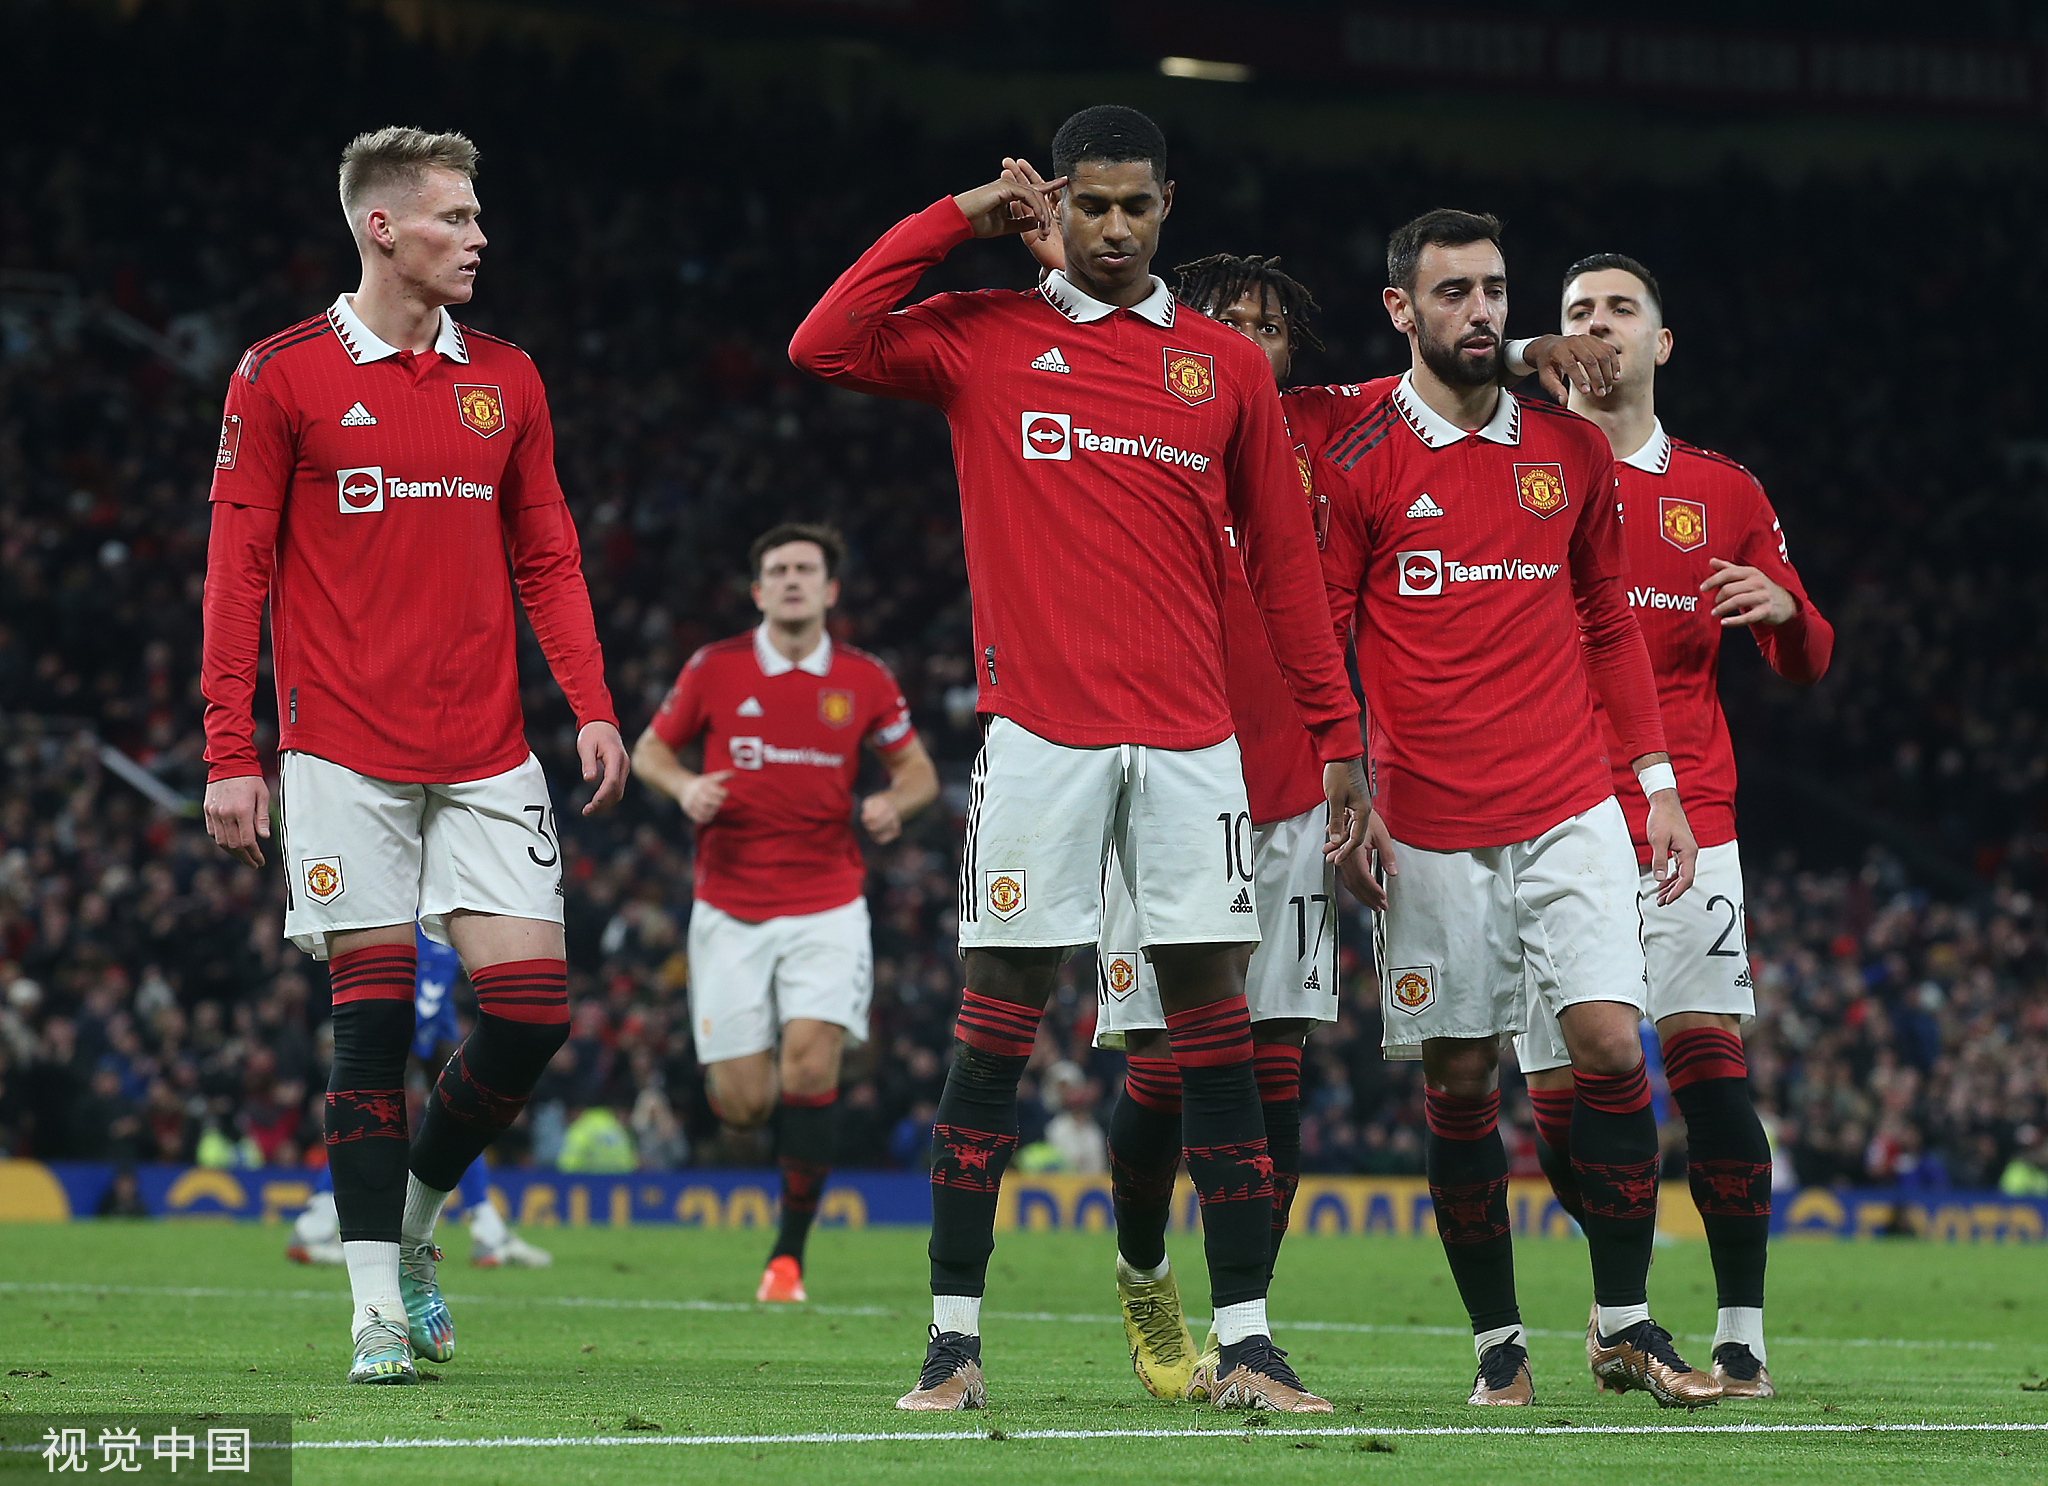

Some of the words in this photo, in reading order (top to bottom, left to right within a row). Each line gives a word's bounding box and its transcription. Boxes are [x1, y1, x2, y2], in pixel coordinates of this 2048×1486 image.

[1031, 360, 1071, 374] adidas
[340, 416, 378, 427] adidas
[1073, 427, 1211, 473] TeamViewer
[385, 476, 493, 501] TeamViewe
[1406, 507, 1444, 519] adidas
[1627, 586, 1698, 612] Viewer
[1217, 811, 1254, 883] 10
[1288, 894, 1329, 963] 17
